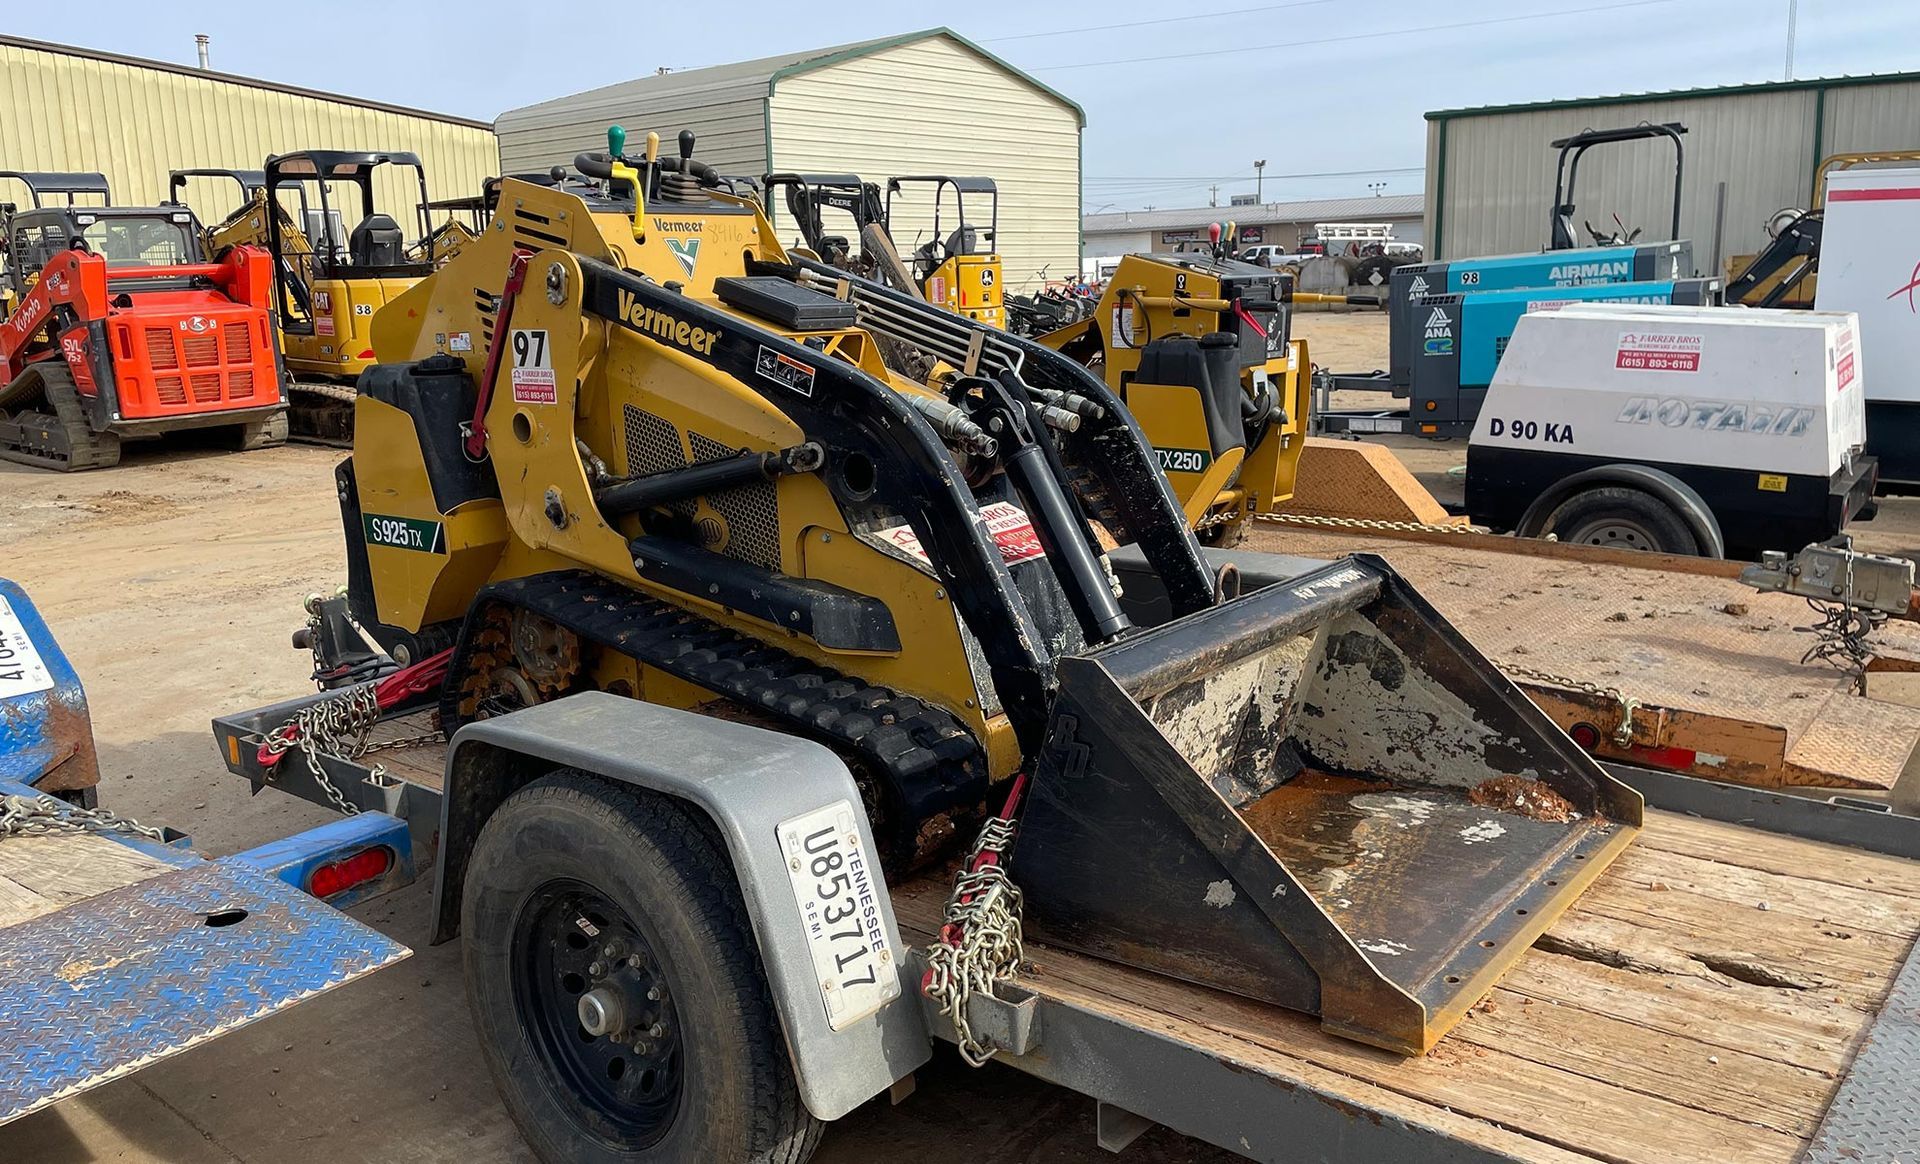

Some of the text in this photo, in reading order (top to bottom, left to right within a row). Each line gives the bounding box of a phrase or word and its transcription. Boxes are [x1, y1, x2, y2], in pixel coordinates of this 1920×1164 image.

[829, 197, 852, 207] DEERE
[653, 217, 703, 232] Vermeer
[1463, 272, 1479, 285] 98
[1549, 262, 1628, 280] AIRMAN
[314, 292, 329, 310] CAT
[356, 305, 371, 315] 38
[15, 298, 41, 333] Kubota
[617, 287, 717, 357] Vermeer
[1424, 327, 1452, 339] ANA
[1640, 334, 1702, 344] FARRER BROS
[63, 339, 82, 352] SVL
[513, 331, 546, 367] 97
[1621, 358, 1694, 369] (615) 893-6118
[1489, 417, 1574, 445] D 90 KA
[803, 826, 876, 989] U853717
[847, 847, 884, 953] TENNESSEE
[805, 900, 823, 941] SEMI
